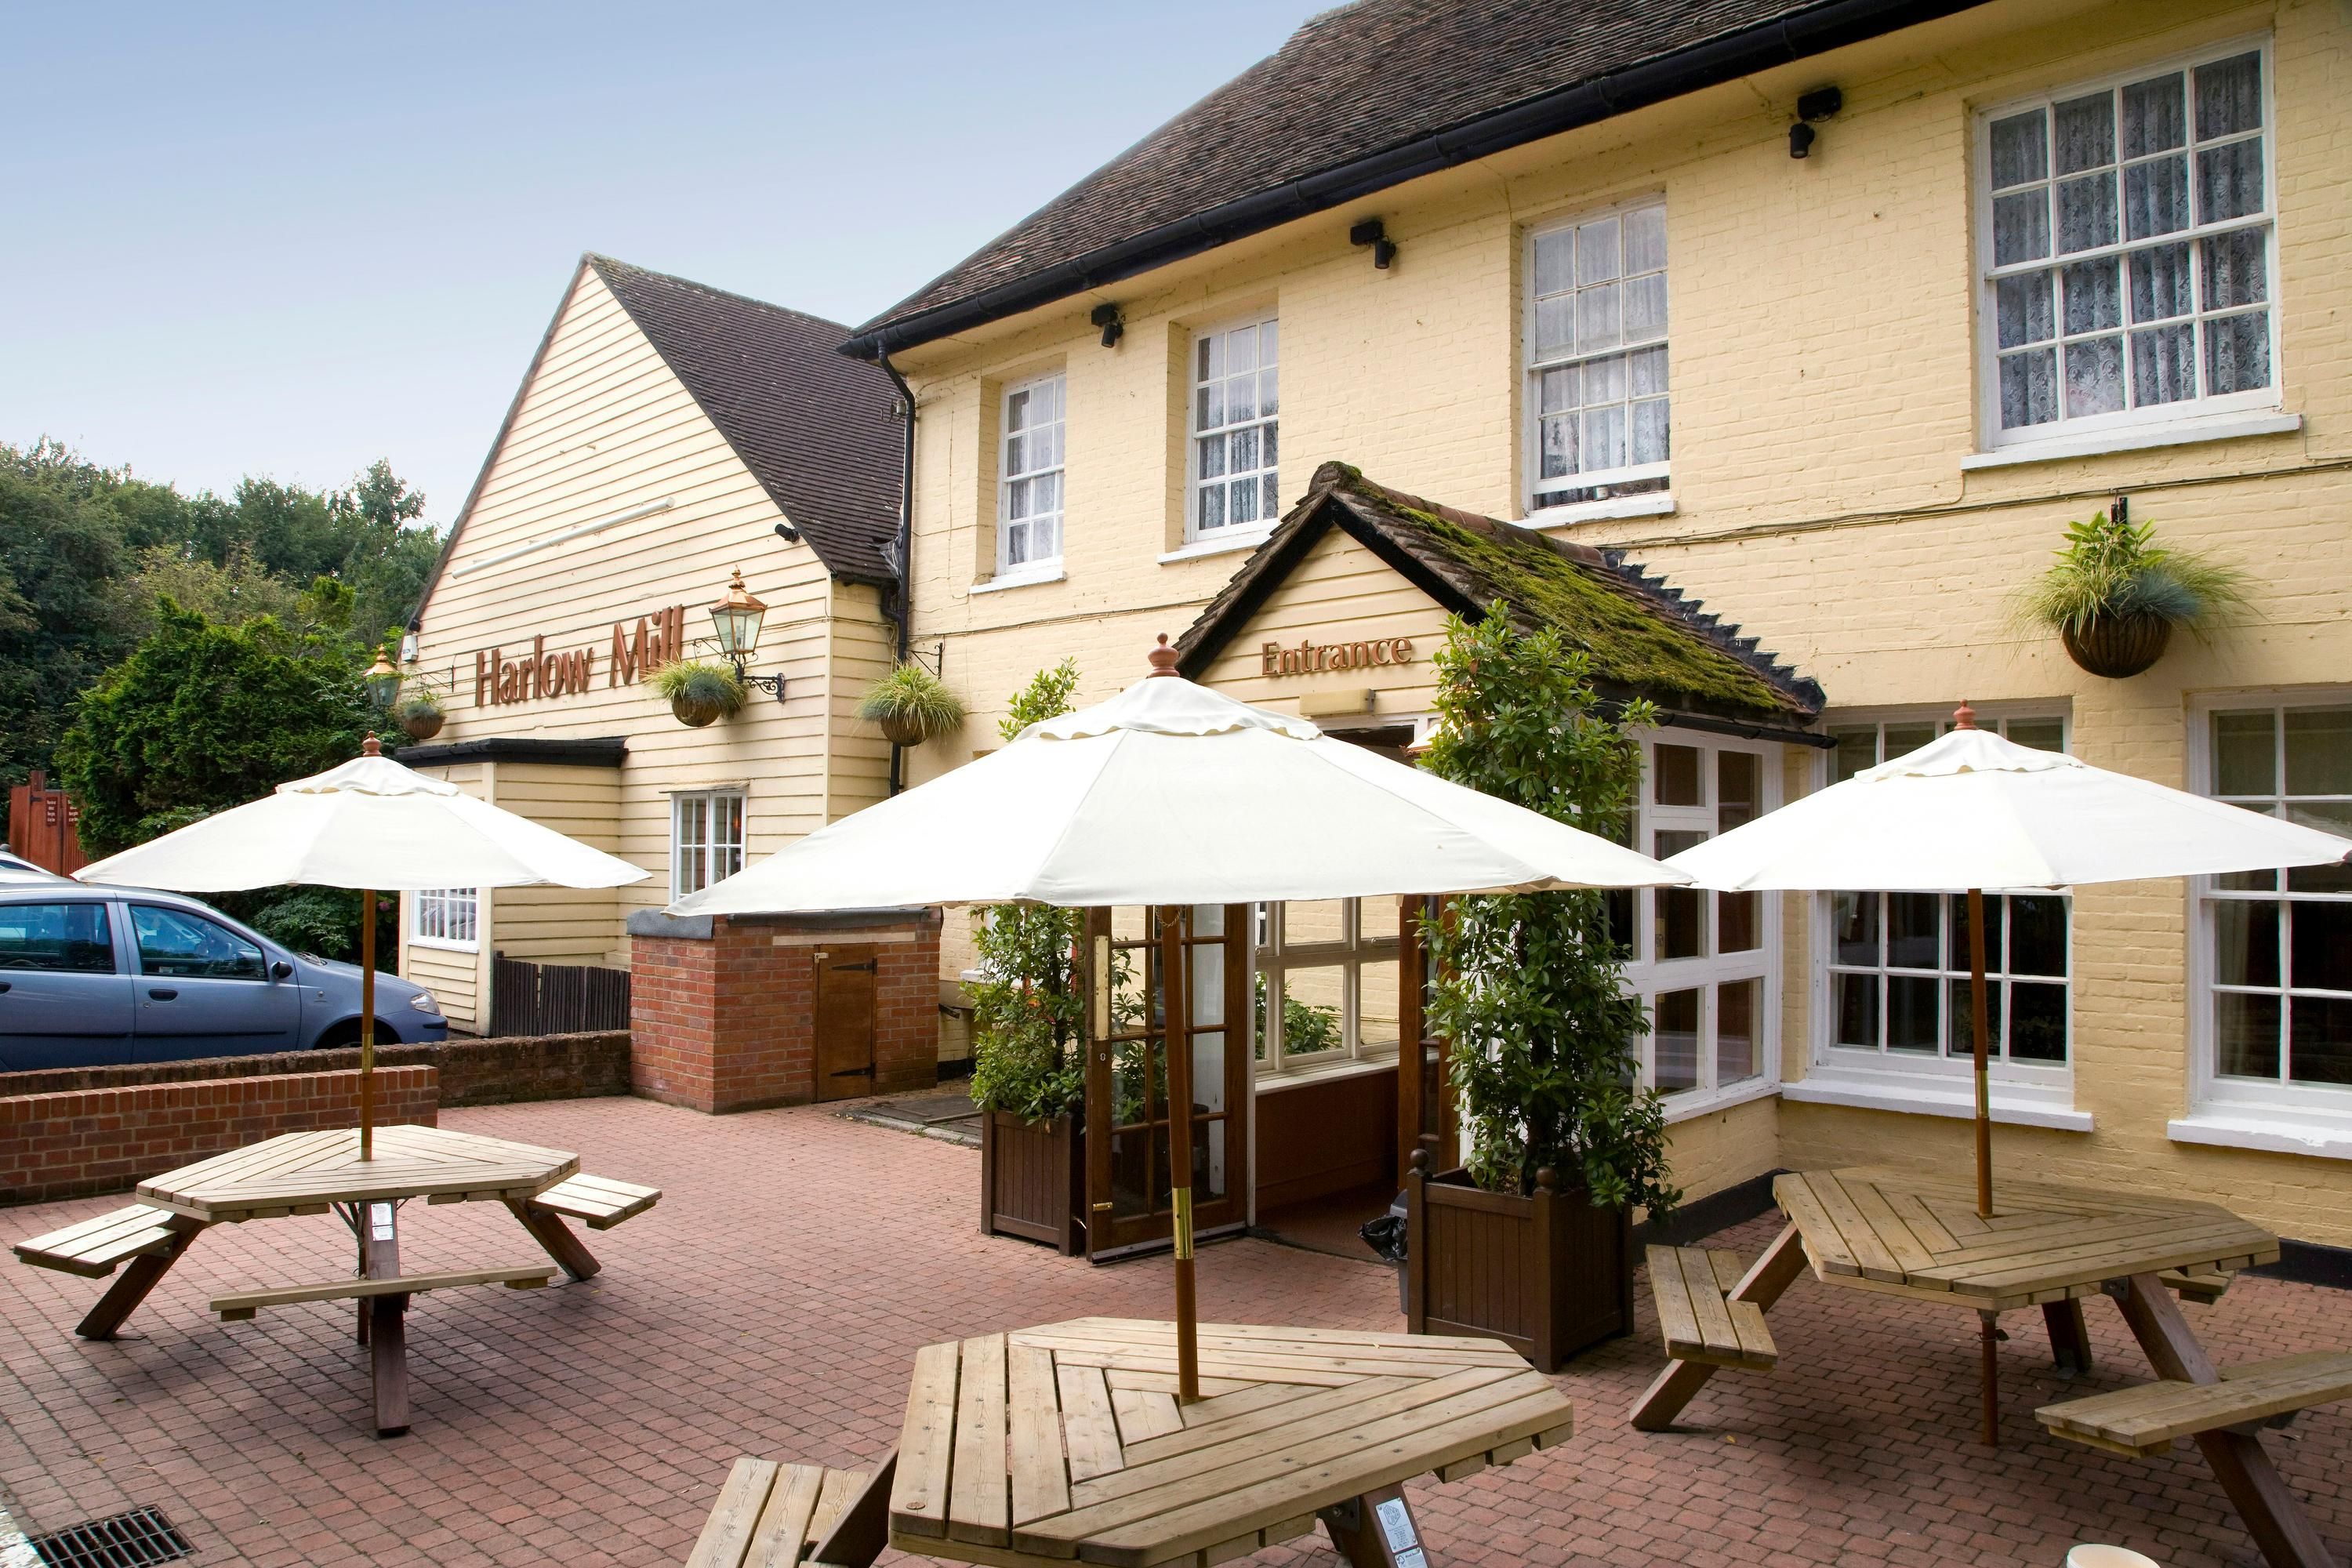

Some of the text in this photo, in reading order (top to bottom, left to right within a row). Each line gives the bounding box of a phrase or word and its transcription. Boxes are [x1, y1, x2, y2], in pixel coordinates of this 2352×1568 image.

[475, 603, 684, 707] Harlow Mill
[1261, 637, 1412, 676] Entrance
